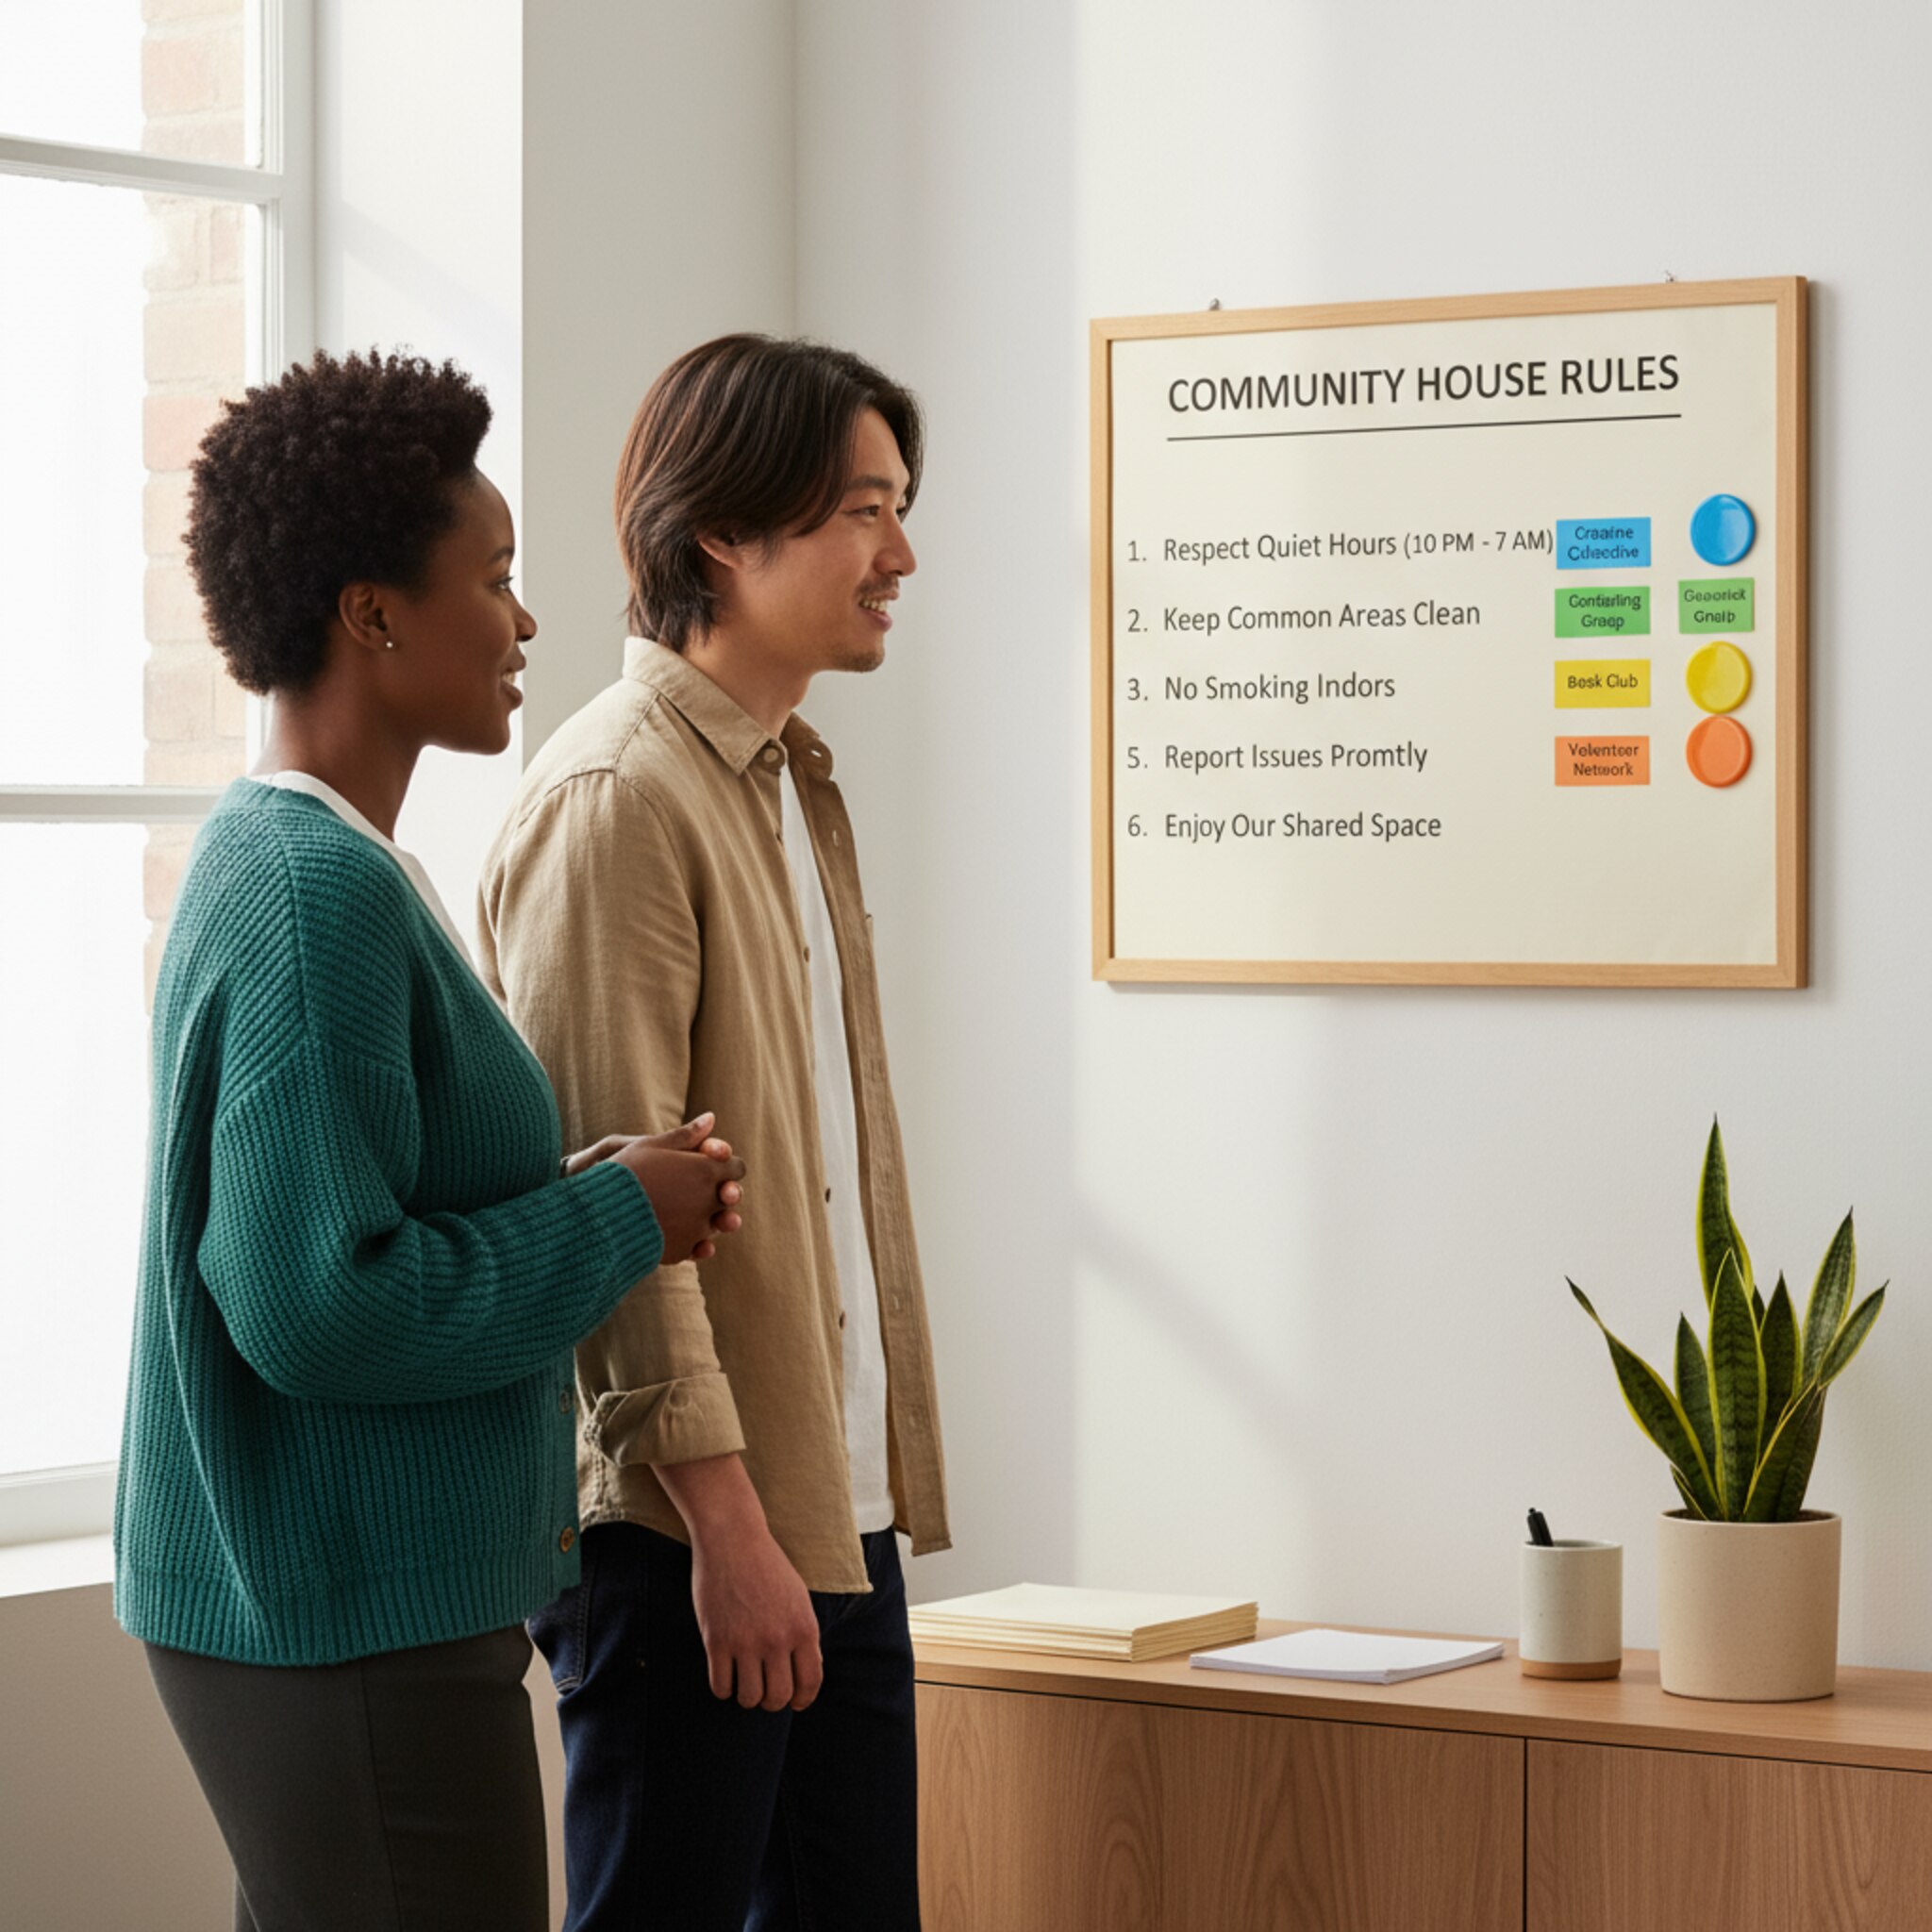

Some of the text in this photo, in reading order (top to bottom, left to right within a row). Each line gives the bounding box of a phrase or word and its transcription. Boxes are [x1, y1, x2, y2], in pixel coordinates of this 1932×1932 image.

[1168, 354, 1679, 413] COMMUNITY HOUSE RULES
[1127, 540, 1147, 562] 1.
[1164, 537, 1250, 567] Respect
[1257, 533, 1322, 561] Quiet
[1329, 532, 1397, 557] Hours
[1403, 532, 1437, 560] (10
[1442, 532, 1474, 552] PM
[1494, 530, 1507, 552] 7
[1511, 528, 1554, 555] AM)
[1127, 599, 1480, 637] 2. Keep Common Areas Clean
[1127, 671, 1396, 706] 3. No Smoking Indors
[1606, 673, 1639, 689] Club
[1127, 740, 1428, 775] 5. Report Issues Promtly
[1127, 810, 1442, 844] 6. Enjoy Our Shared Space
